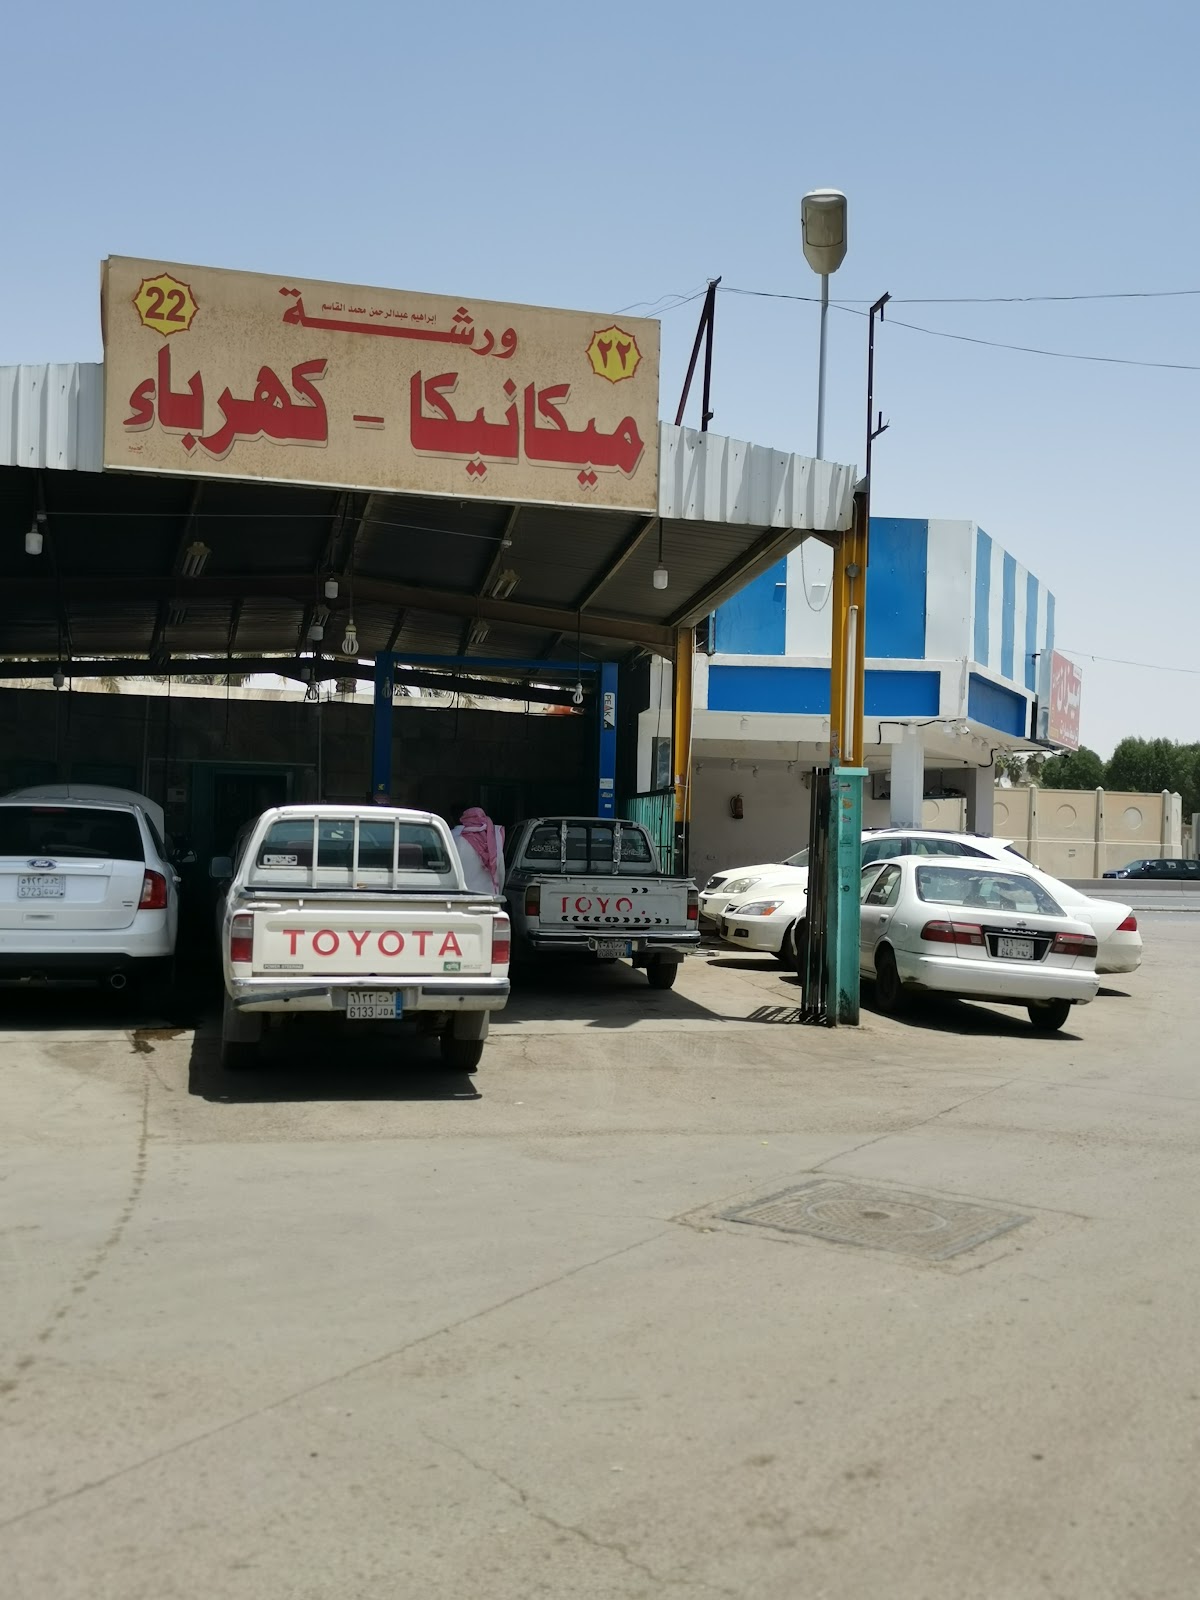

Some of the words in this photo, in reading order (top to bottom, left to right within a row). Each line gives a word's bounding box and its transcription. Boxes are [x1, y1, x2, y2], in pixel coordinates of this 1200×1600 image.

[145, 286, 186, 322] 22
[321, 302, 345, 312] القاسم
[348, 305, 366, 314] محمد
[597, 338, 631, 371] ٢٢
[123, 343, 328, 457] كهرباء
[410, 370, 645, 488] ميكانيكا
[20, 887, 42, 896] 5723
[282, 929, 463, 956] TOYOTA
[350, 1006, 374, 1018] 6133
[378, 1007, 394, 1016] JDA
